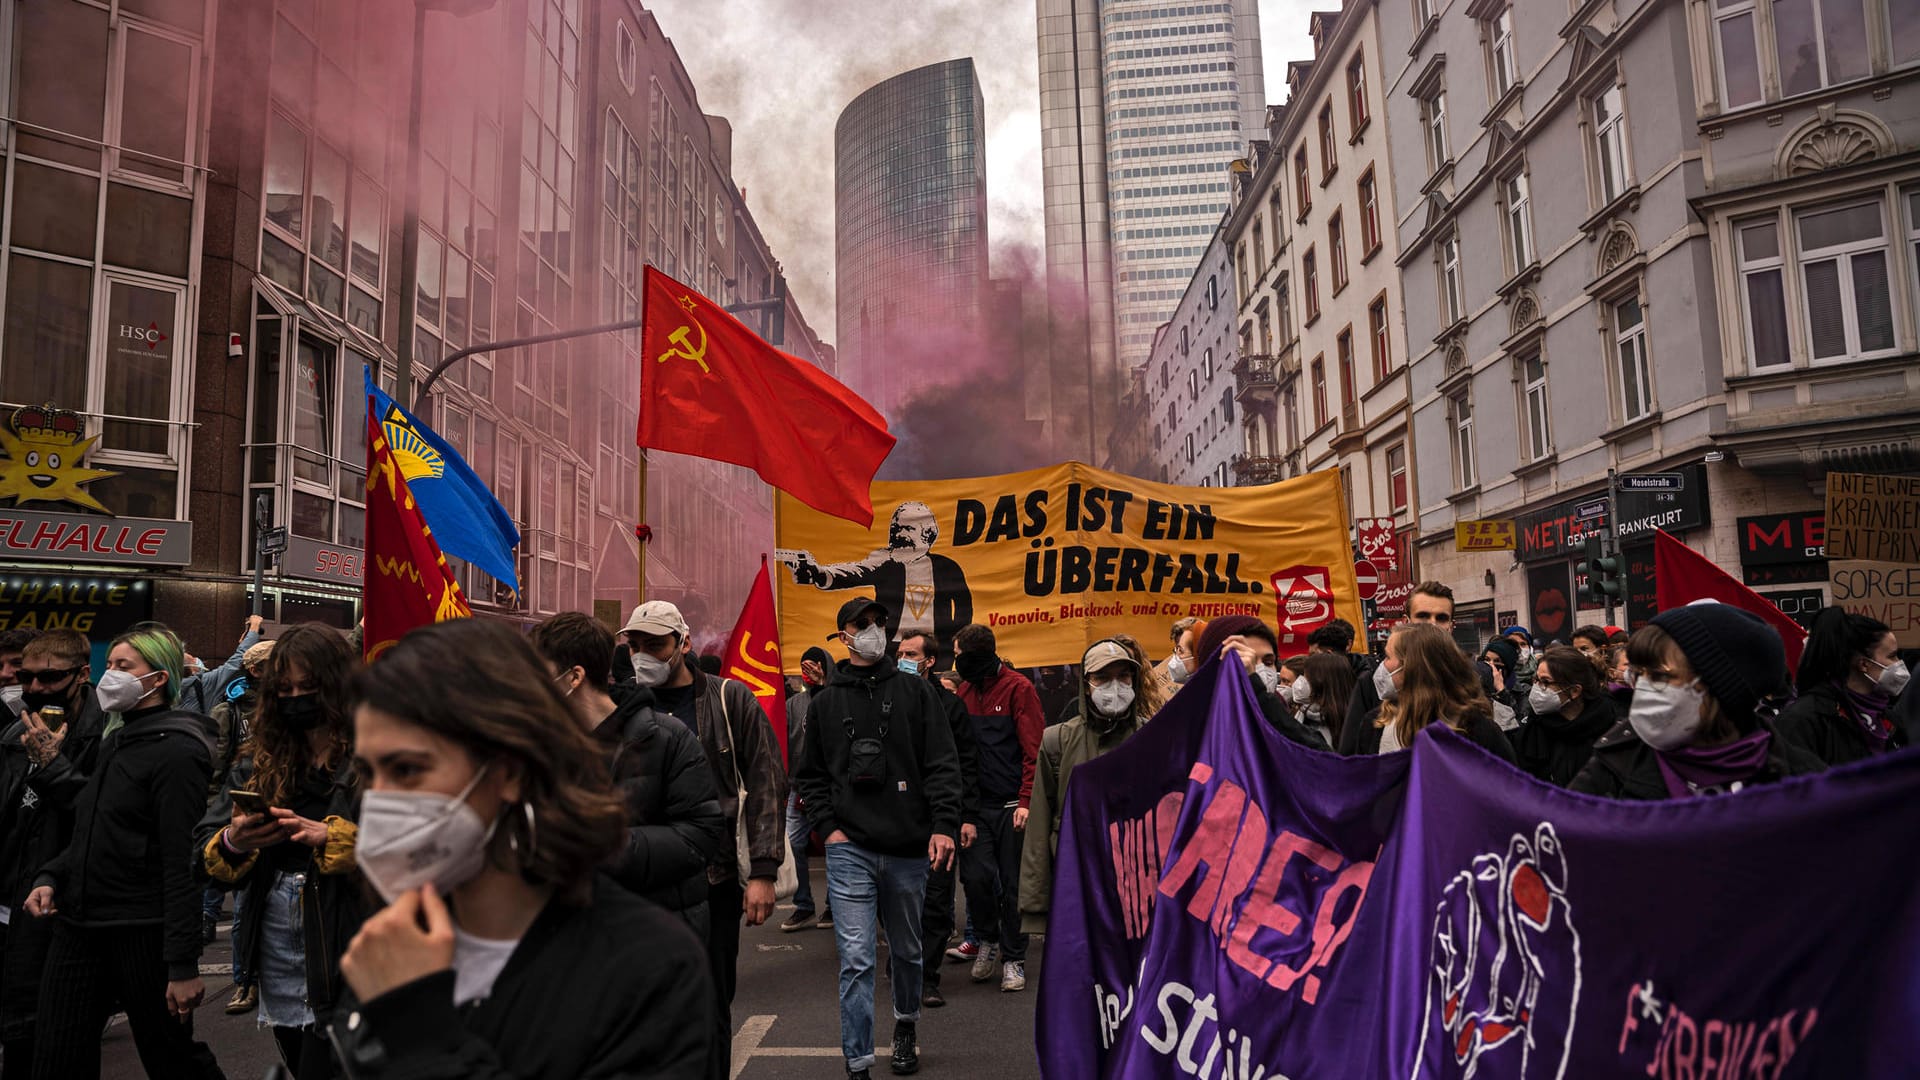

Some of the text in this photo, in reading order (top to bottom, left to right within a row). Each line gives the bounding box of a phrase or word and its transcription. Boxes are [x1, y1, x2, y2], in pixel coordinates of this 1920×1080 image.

[120, 324, 160, 342] HSC
[1631, 478, 1671, 487] Moselstraße
[952, 483, 1217, 546] DAS IST EIN
[1619, 508, 1683, 536] RANKFURT
[1466, 522, 1510, 534] SEX
[1362, 529, 1392, 556] Eros
[1467, 535, 1493, 546] Inn
[1023, 536, 1264, 597] ÜBERFALL.
[1375, 583, 1409, 605] Eros
[1834, 569, 1920, 600] SORGE
[989, 608, 1055, 626] Vonovia,
[1060, 601, 1124, 619] Blackrock
[1132, 602, 1158, 616] und
[1188, 603, 1262, 617] ENTEIGNEN
[1376, 604, 1405, 613] EINGANG
